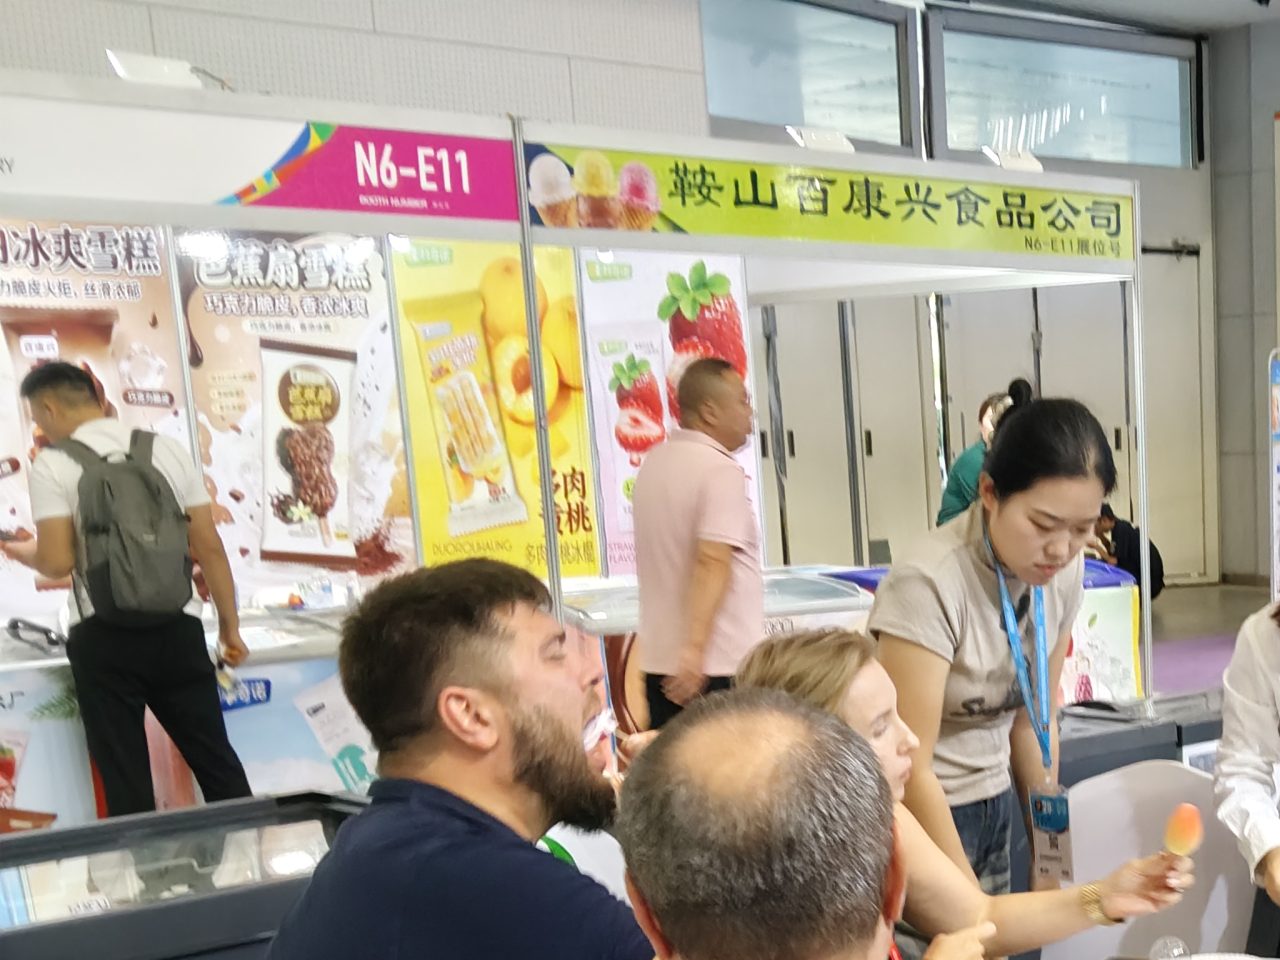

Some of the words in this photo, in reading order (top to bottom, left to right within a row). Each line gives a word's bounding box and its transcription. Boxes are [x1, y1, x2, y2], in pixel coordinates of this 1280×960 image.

[354, 140, 471, 194] N6-E11
[667, 160, 1122, 238] 鞍山百康兴食品公司
